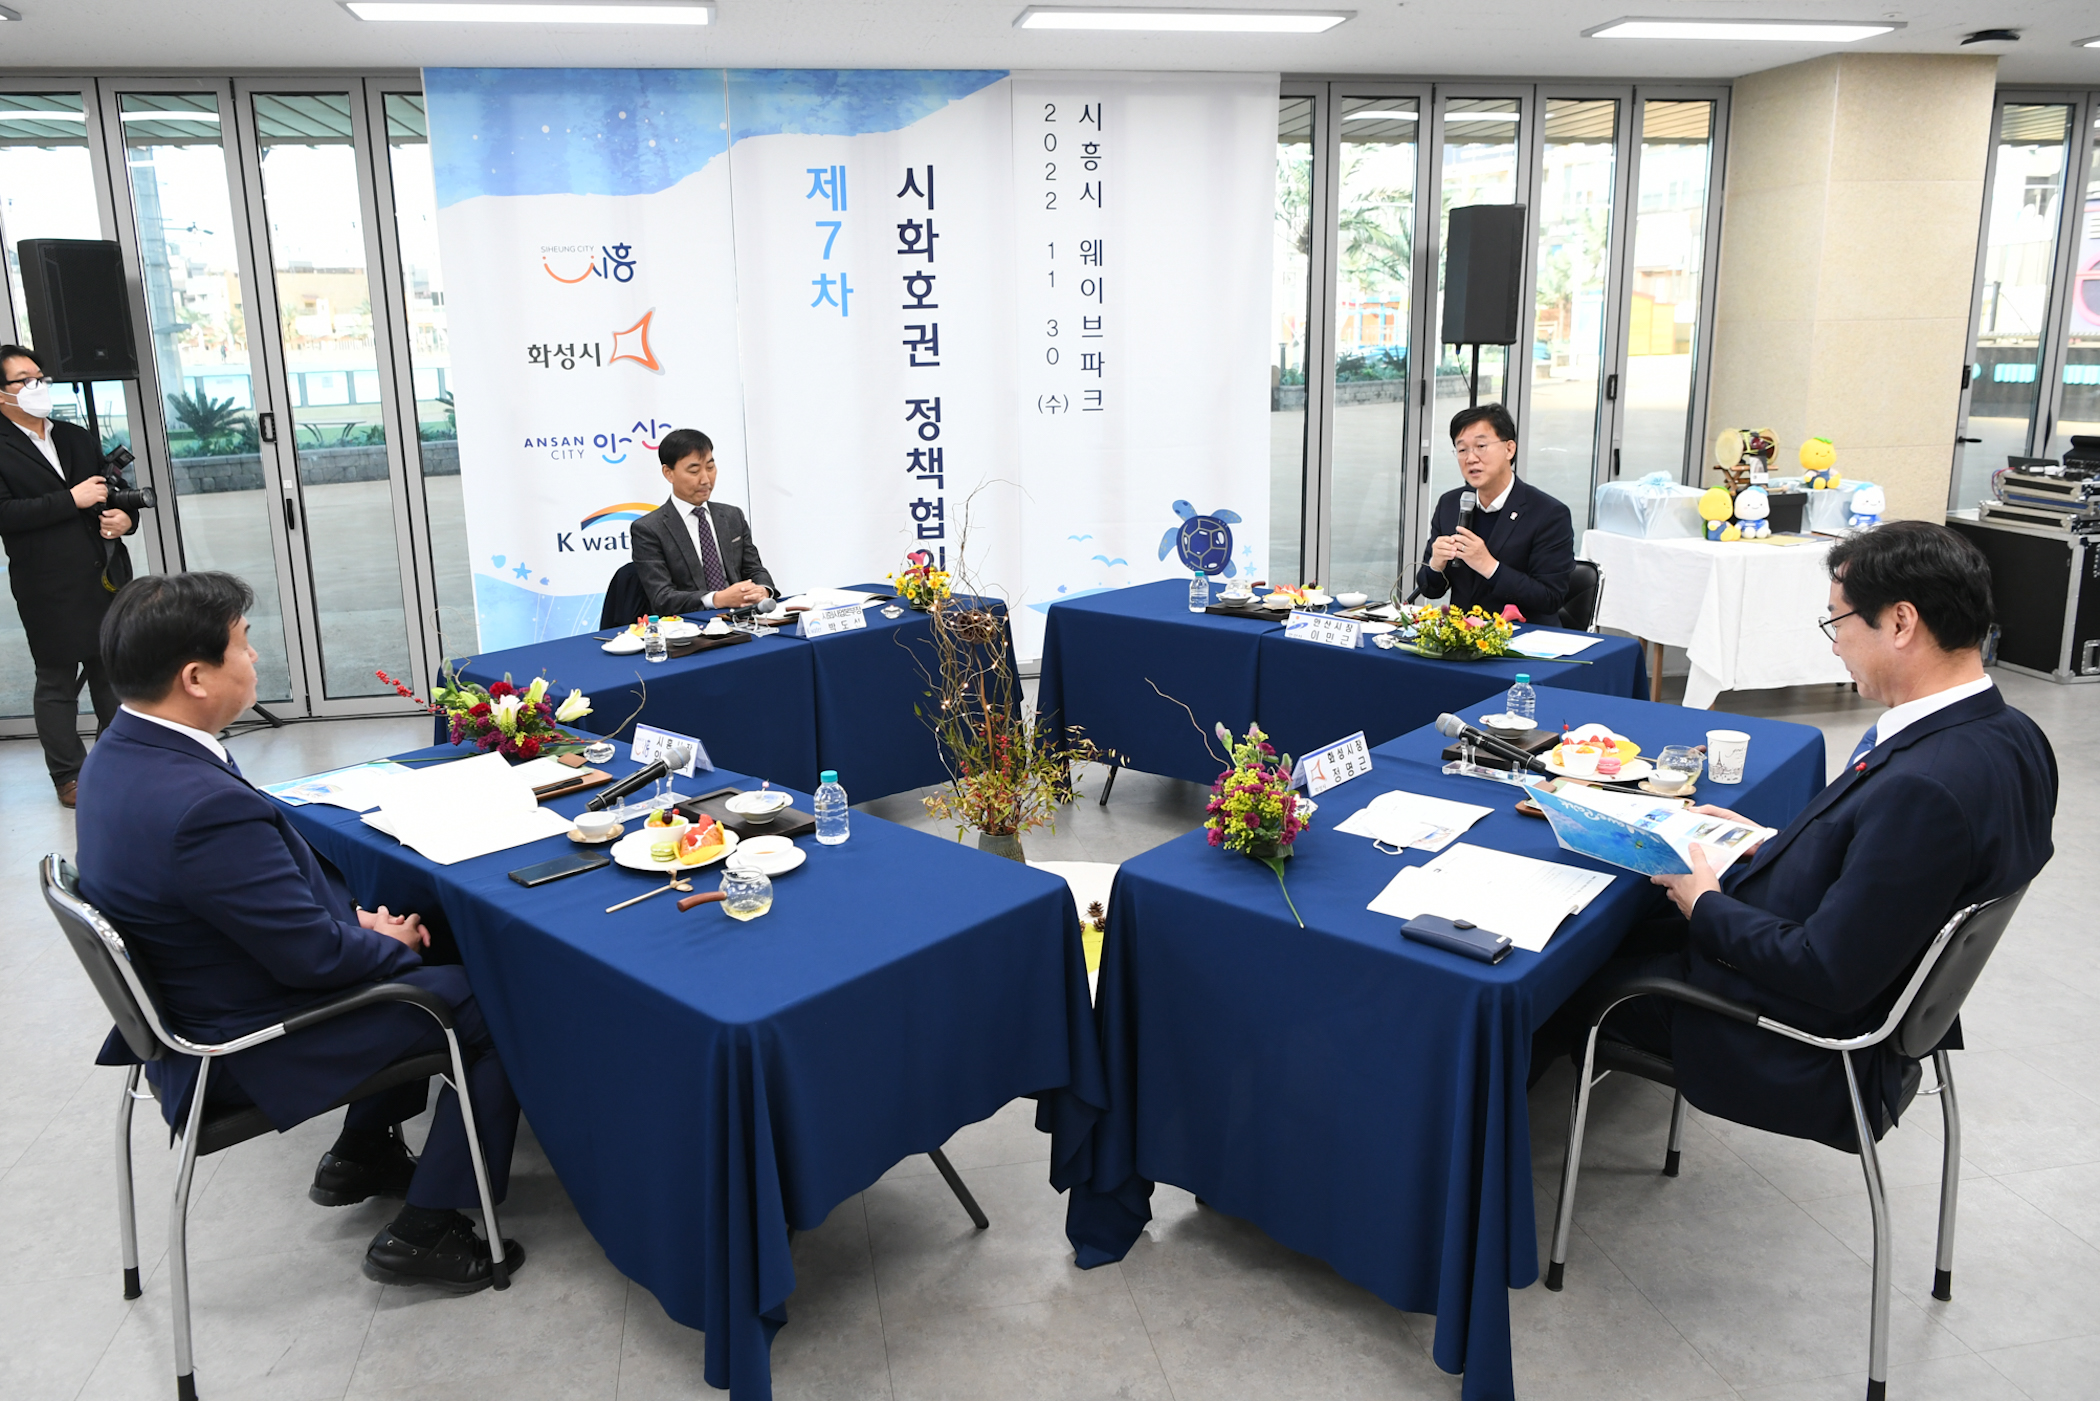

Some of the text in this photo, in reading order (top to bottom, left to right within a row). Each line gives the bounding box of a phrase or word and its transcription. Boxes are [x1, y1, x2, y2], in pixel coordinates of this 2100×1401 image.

[576, 245, 595, 253] CITY
[805, 164, 854, 317] 제7차
[896, 164, 941, 368] 시화호권
[1037, 103, 1069, 415] 2022 11 30 (수)
[1078, 103, 1106, 412] 시흥시 웨이브파크
[527, 342, 602, 371] 화성시
[524, 436, 585, 448] ANSAN
[551, 449, 585, 461] CITY
[582, 531, 635, 551] wat
[1313, 618, 1353, 633] 안산시장
[1310, 630, 1350, 646] 이민근
[656, 736, 693, 749] 시흥
[1327, 739, 1363, 764] 화성시장
[1332, 755, 1367, 783] 정명근
